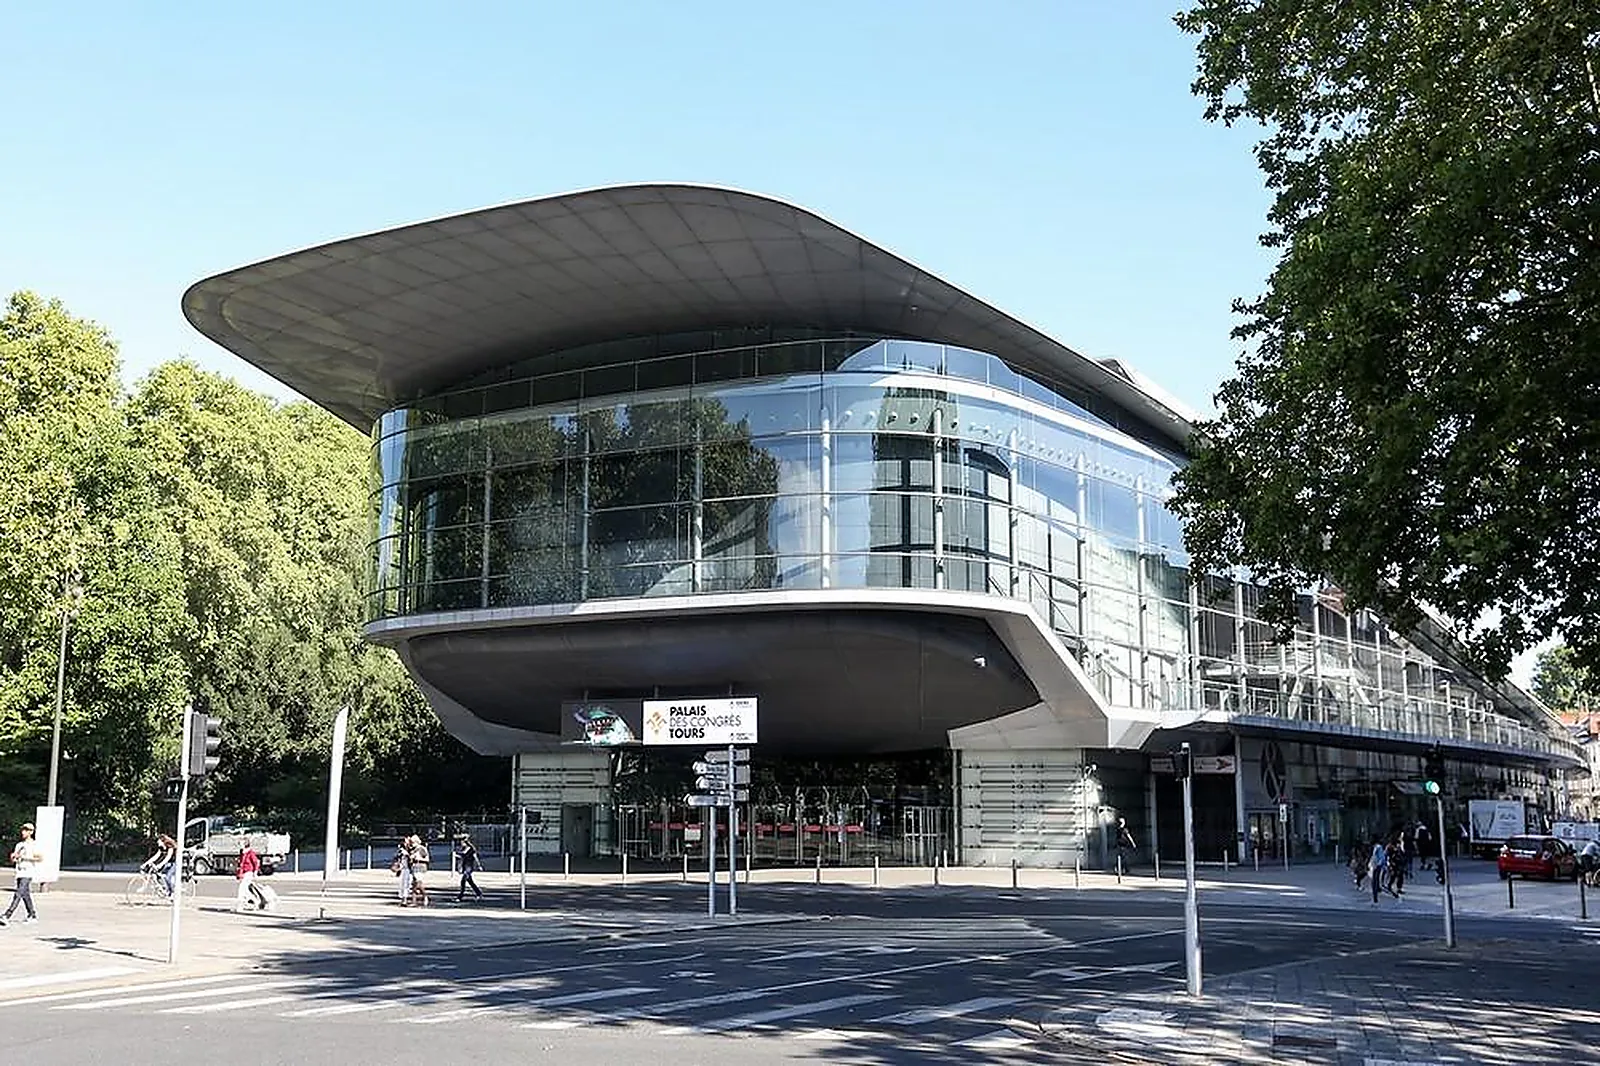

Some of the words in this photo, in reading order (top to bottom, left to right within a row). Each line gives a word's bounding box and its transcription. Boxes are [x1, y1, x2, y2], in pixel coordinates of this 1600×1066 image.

[669, 705, 706, 716] PALAIS
[669, 717, 688, 727] DES
[669, 728, 705, 738] TOURS
